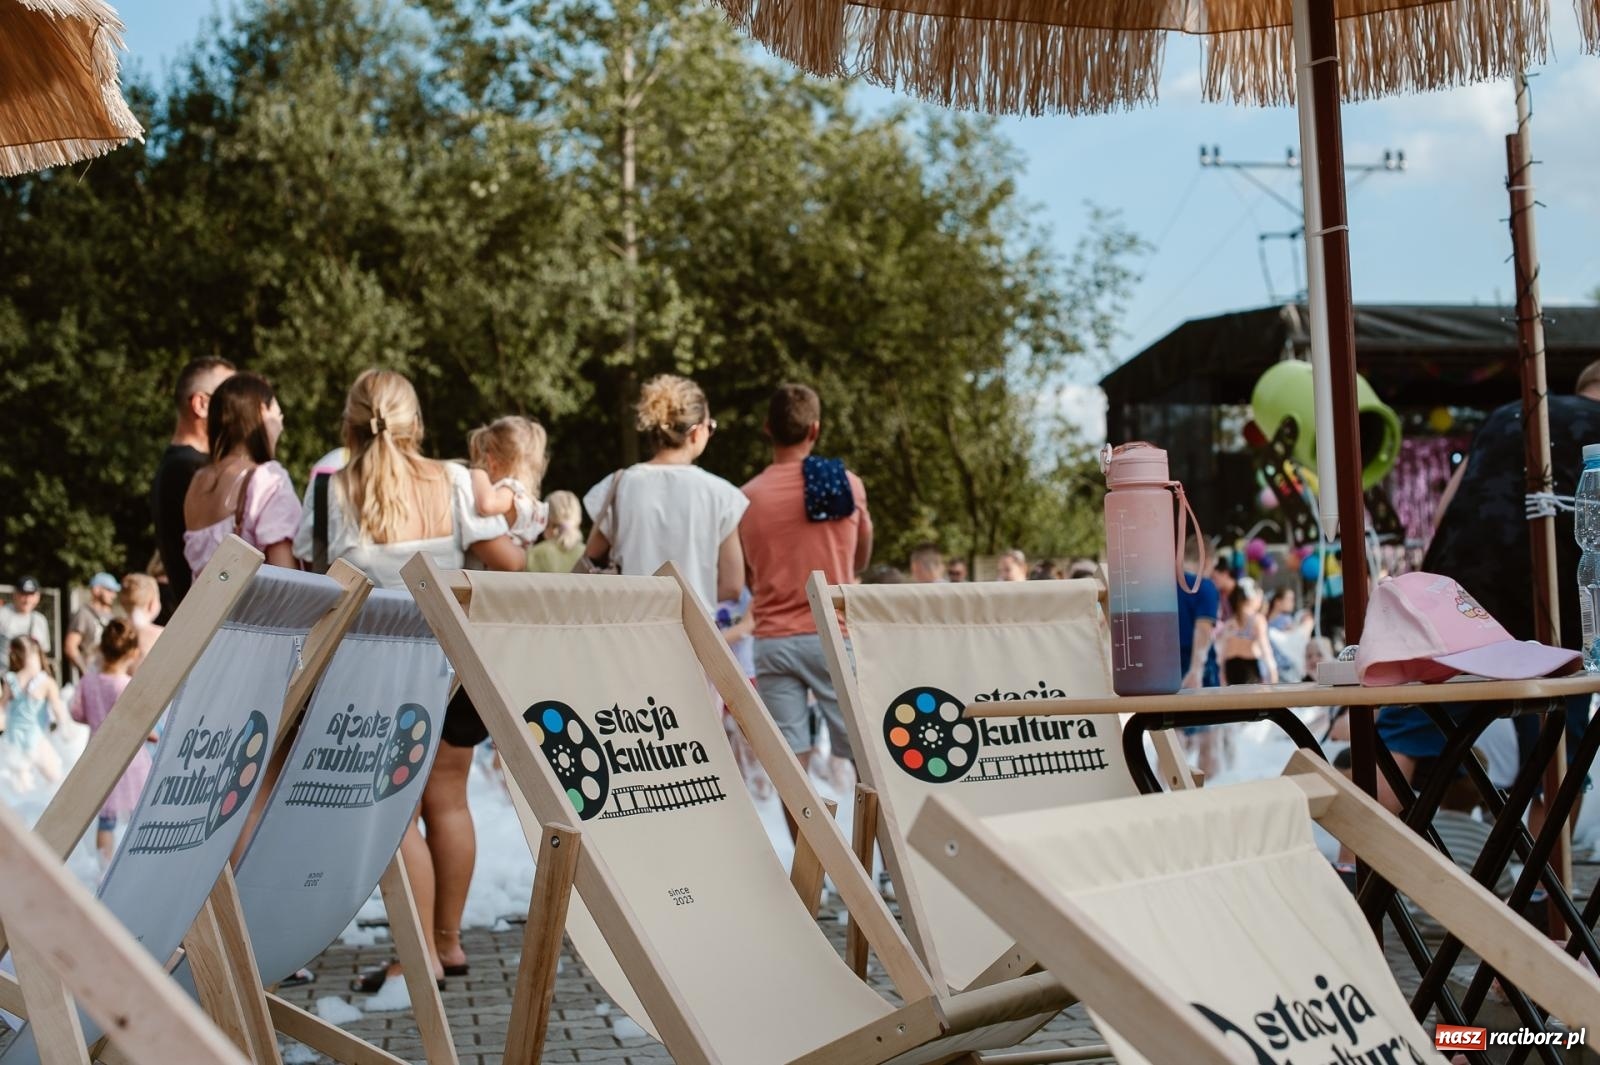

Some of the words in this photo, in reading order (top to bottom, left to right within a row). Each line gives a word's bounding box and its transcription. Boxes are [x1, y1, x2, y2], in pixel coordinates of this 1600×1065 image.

[594, 696, 679, 741] stacja
[978, 716, 1097, 747] kultura
[602, 738, 709, 775] kultura
[667, 887, 690, 897] since
[673, 894, 694, 906] 2023
[1254, 974, 1375, 1050] stacja
